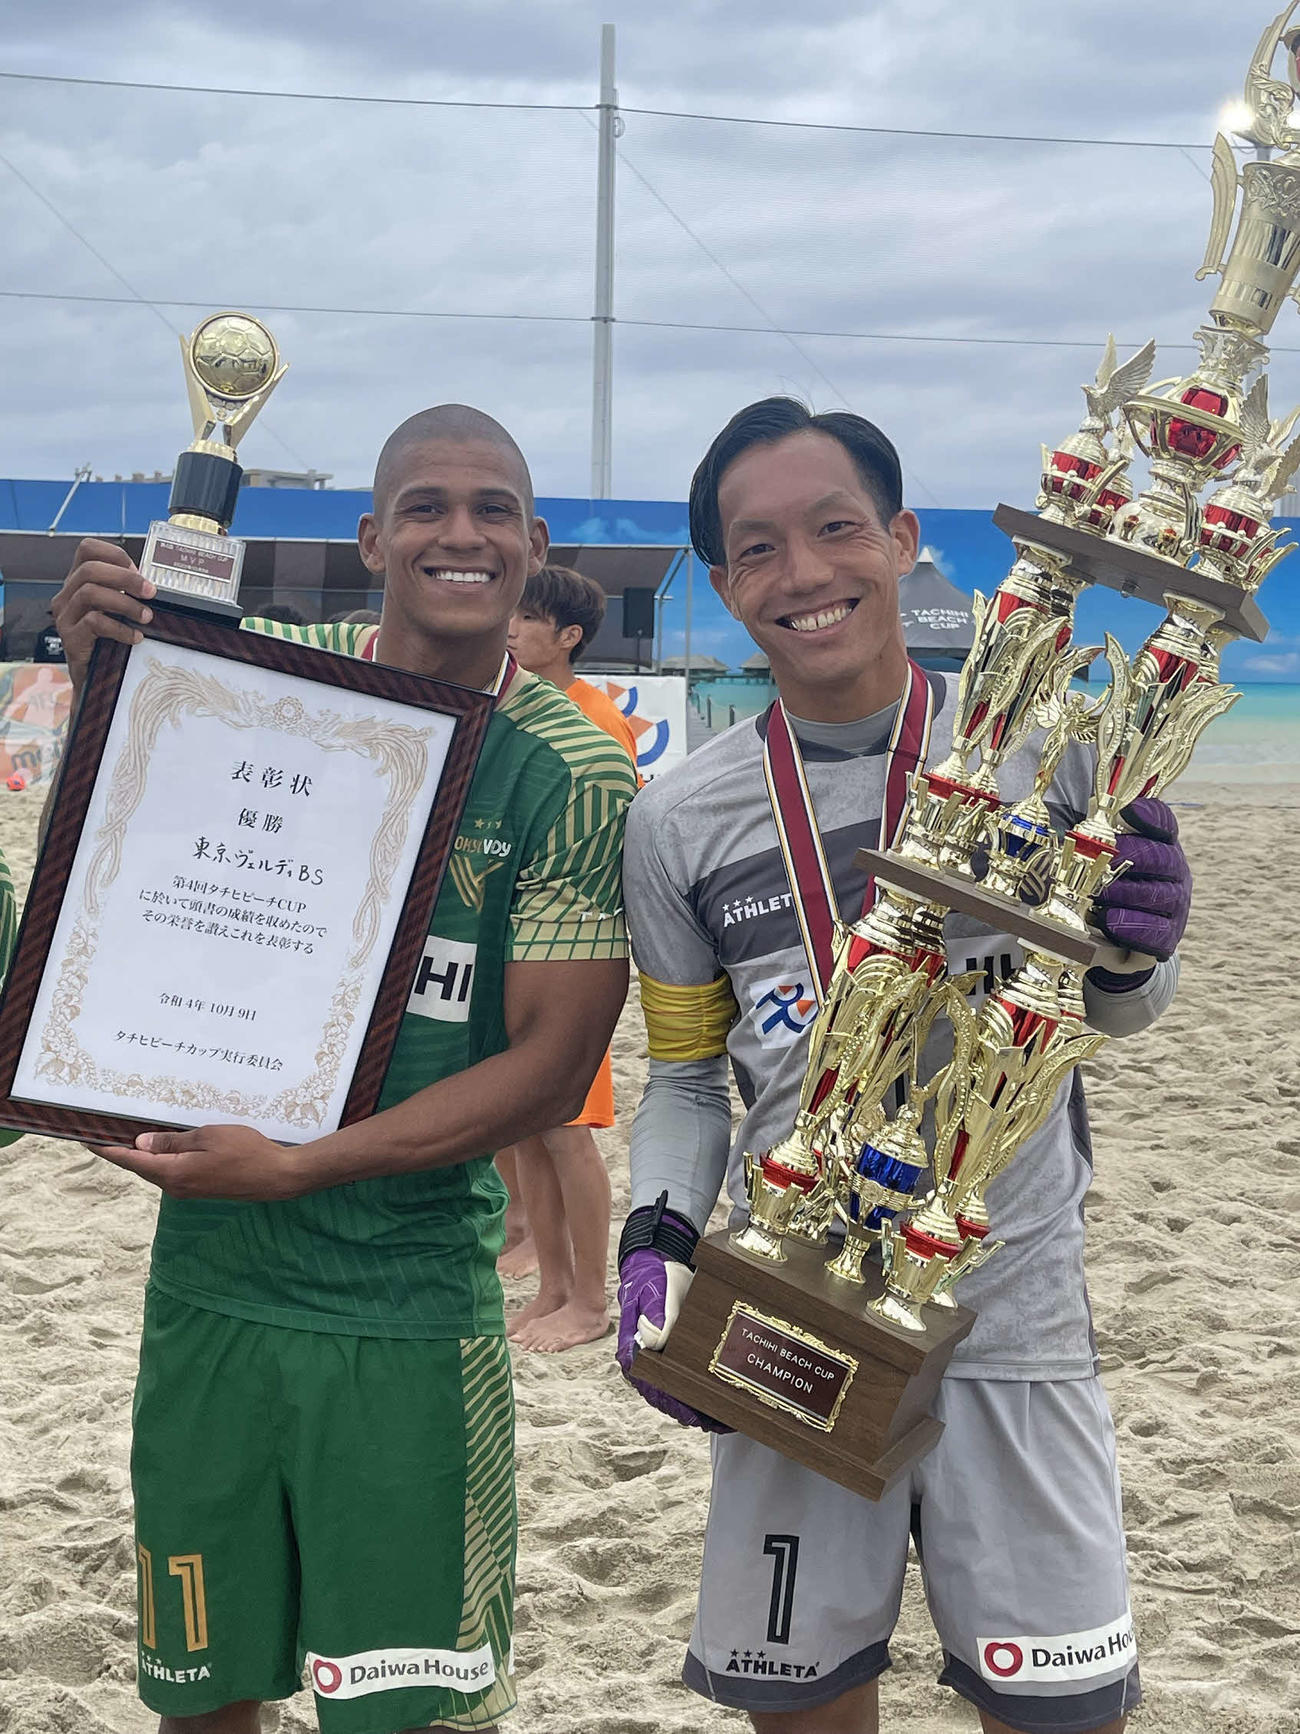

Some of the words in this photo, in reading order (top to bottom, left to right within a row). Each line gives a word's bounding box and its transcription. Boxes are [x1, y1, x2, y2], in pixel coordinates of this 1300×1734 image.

[911, 608, 969, 618] TACHIHI
[917, 616, 968, 624] BEACH
[231, 760, 313, 797] 表彰状
[238, 807, 284, 834] 優勝
[723, 893, 792, 928] ATHLET
[741, 1328, 778, 1353] TACHIHI
[780, 1348, 813, 1371] BEACH
[814, 1366, 835, 1382] CUP
[746, 1353, 814, 1394] CHAMPION
[138, 1541, 208, 1653] 11
[762, 1533, 800, 1645] 1
[725, 1657, 818, 1679] ATHLETA
[1031, 1645, 1107, 1668] Daiwa
[141, 1658, 211, 1684] ATHLETA
[350, 1659, 420, 1685] Daiwa
[424, 1659, 489, 1681] House
